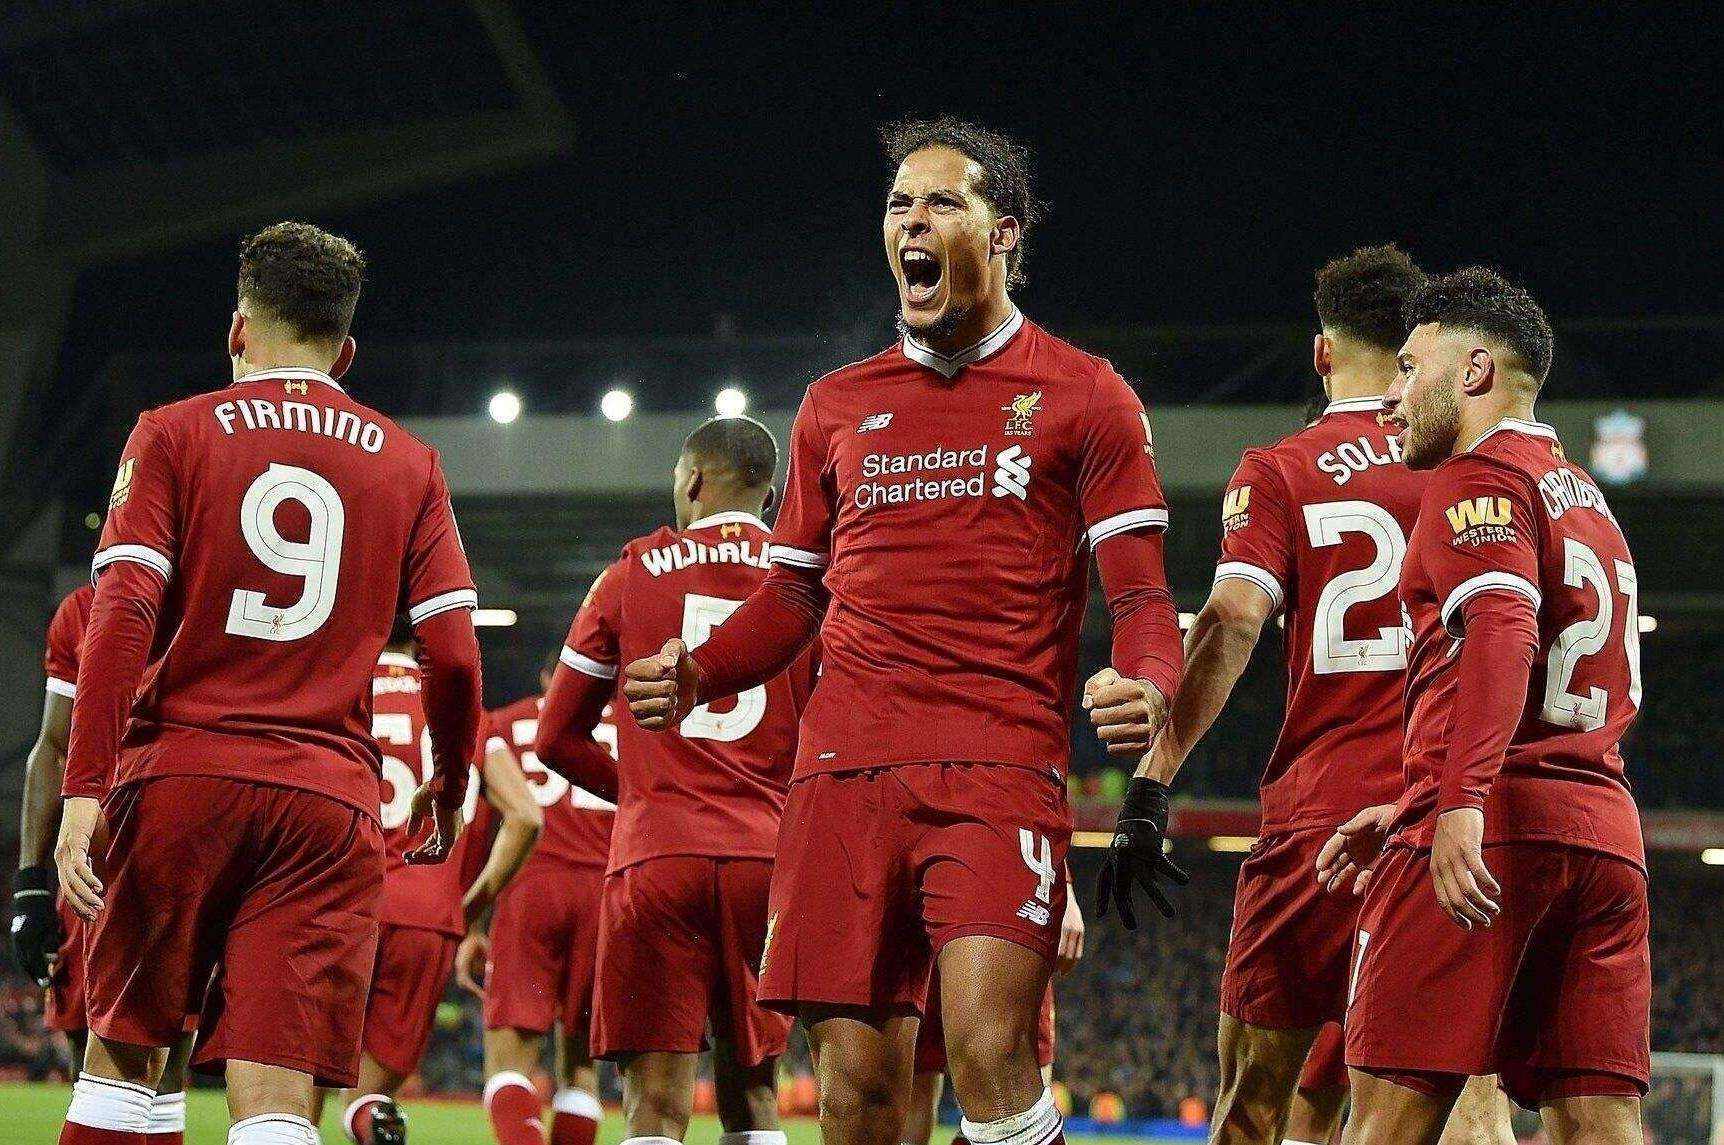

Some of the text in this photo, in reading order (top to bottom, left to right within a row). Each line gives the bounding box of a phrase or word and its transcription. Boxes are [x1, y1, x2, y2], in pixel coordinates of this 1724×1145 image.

[213, 400, 386, 454] FIRMINO
[863, 445, 988, 478] Standard
[854, 472, 985, 509] Chartered
[1445, 496, 1513, 534] WU
[1452, 526, 1517, 546] WESTERN
[225, 462, 345, 642] 9
[1471, 533, 1518, 547] UNION
[1302, 500, 1414, 675] 2
[1540, 537, 1643, 733] 27
[1018, 827, 1057, 904] 4
